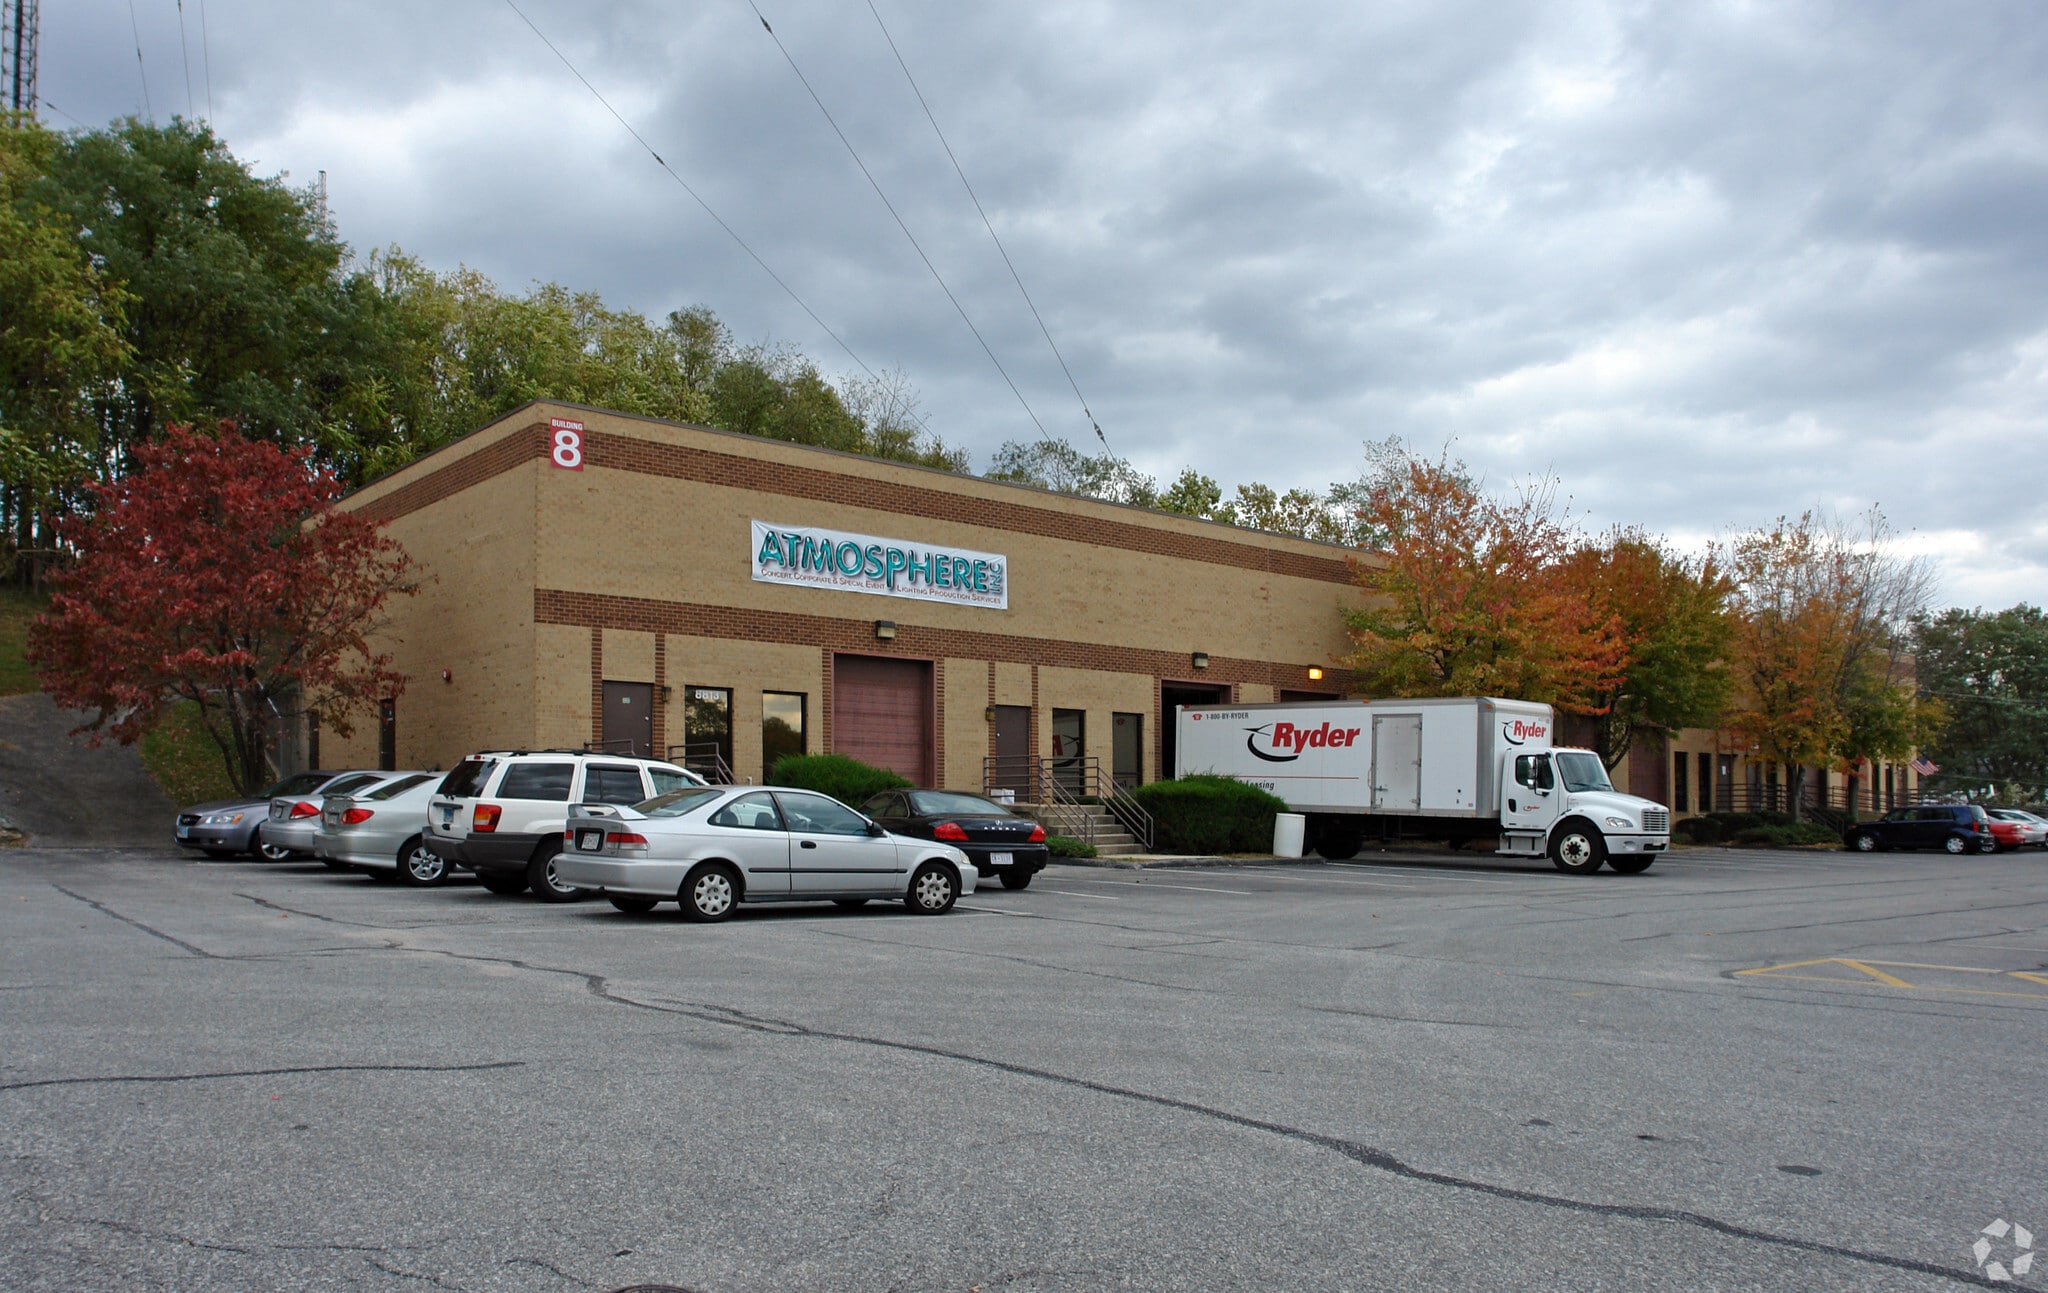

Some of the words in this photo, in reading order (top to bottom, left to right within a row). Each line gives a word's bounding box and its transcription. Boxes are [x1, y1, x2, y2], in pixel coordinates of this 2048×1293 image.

[552, 418, 583, 431] BUILDING
[553, 430, 581, 467] 8
[758, 530, 989, 591] ATMOSPHERE
[832, 577, 838, 585] &
[865, 580, 885, 590] EVENT
[896, 584, 928, 595] LIGHTING
[929, 588, 971, 600] PRODUCTION
[1272, 721, 1361, 754] Ryder
[1513, 720, 1547, 741] Ryder
